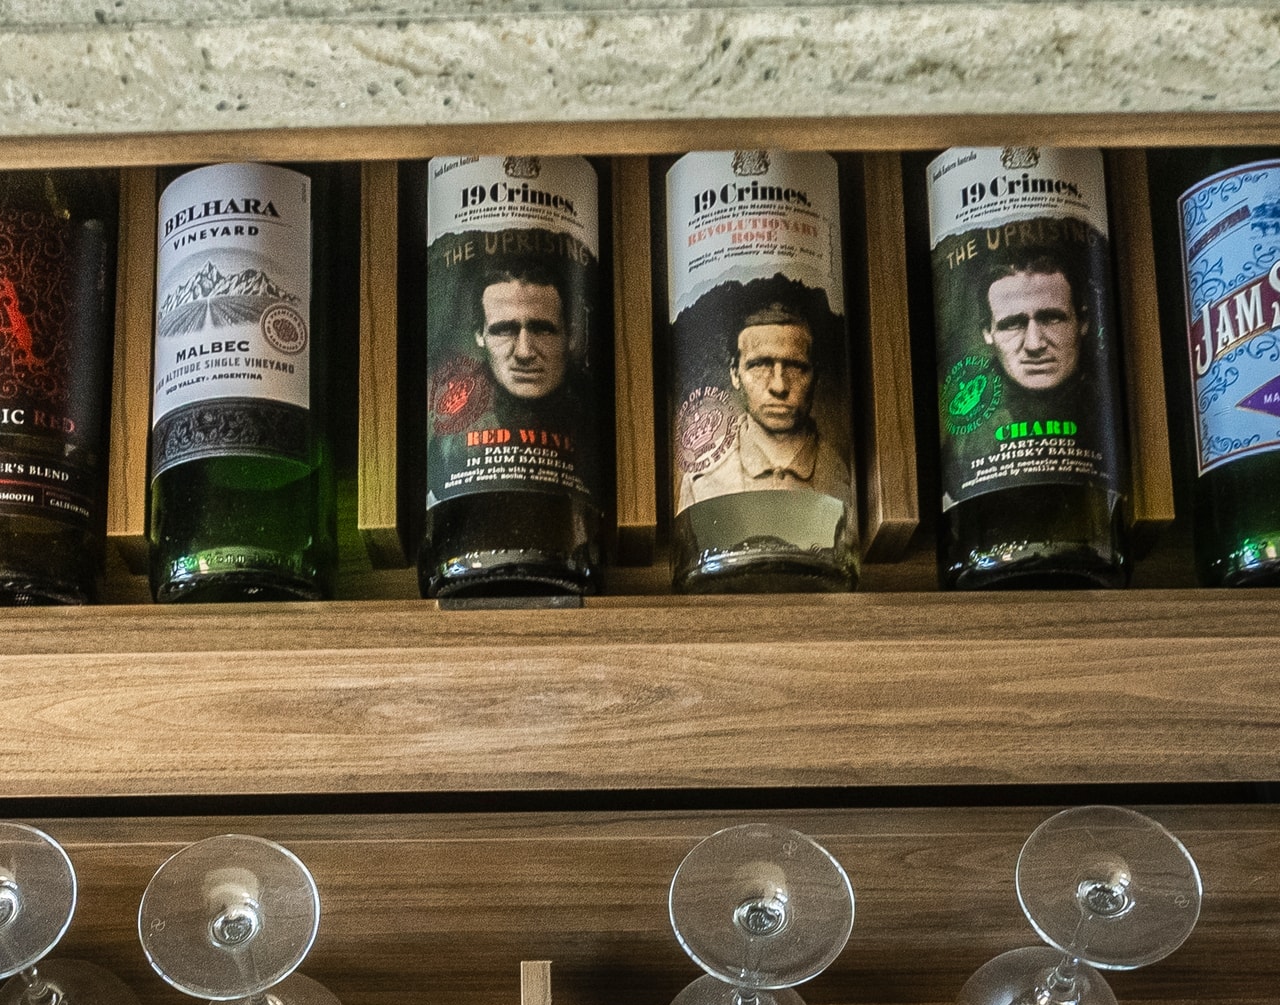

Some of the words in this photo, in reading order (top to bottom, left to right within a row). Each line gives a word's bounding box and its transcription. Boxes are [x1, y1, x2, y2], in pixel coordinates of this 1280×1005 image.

[461, 185, 486, 208] 19
[694, 189, 716, 215] 19
[961, 182, 986, 208] 19
[164, 198, 280, 238] BELHARA
[173, 226, 259, 250] VINEYARD
[687, 218, 818, 247] REVOLUTIONARY
[443, 240, 475, 268] THE
[484, 231, 590, 267] UPRISING
[946, 238, 978, 270] THE
[1195, 282, 1266, 376] JAM
[176, 340, 250, 364] MALBEC
[166, 361, 201, 383] ALTITUDE
[205, 357, 240, 369] SINGLE
[245, 357, 295, 375] VINEYARD
[34, 410, 76, 434] RED
[994, 420, 1077, 441] CHARD
[466, 428, 511, 446] RED
[1000, 438, 1076, 452] PART-AGED
[466, 457, 481, 467] IN
[484, 455, 515, 465] RUM
[519, 456, 574, 471] BARRELS
[484, 446, 558, 458] PART-AGED
[971, 457, 985, 469] IN
[988, 447, 1044, 464] WHISKY
[1048, 447, 1103, 461] BARRELS
[28, 465, 70, 482] BLEND
